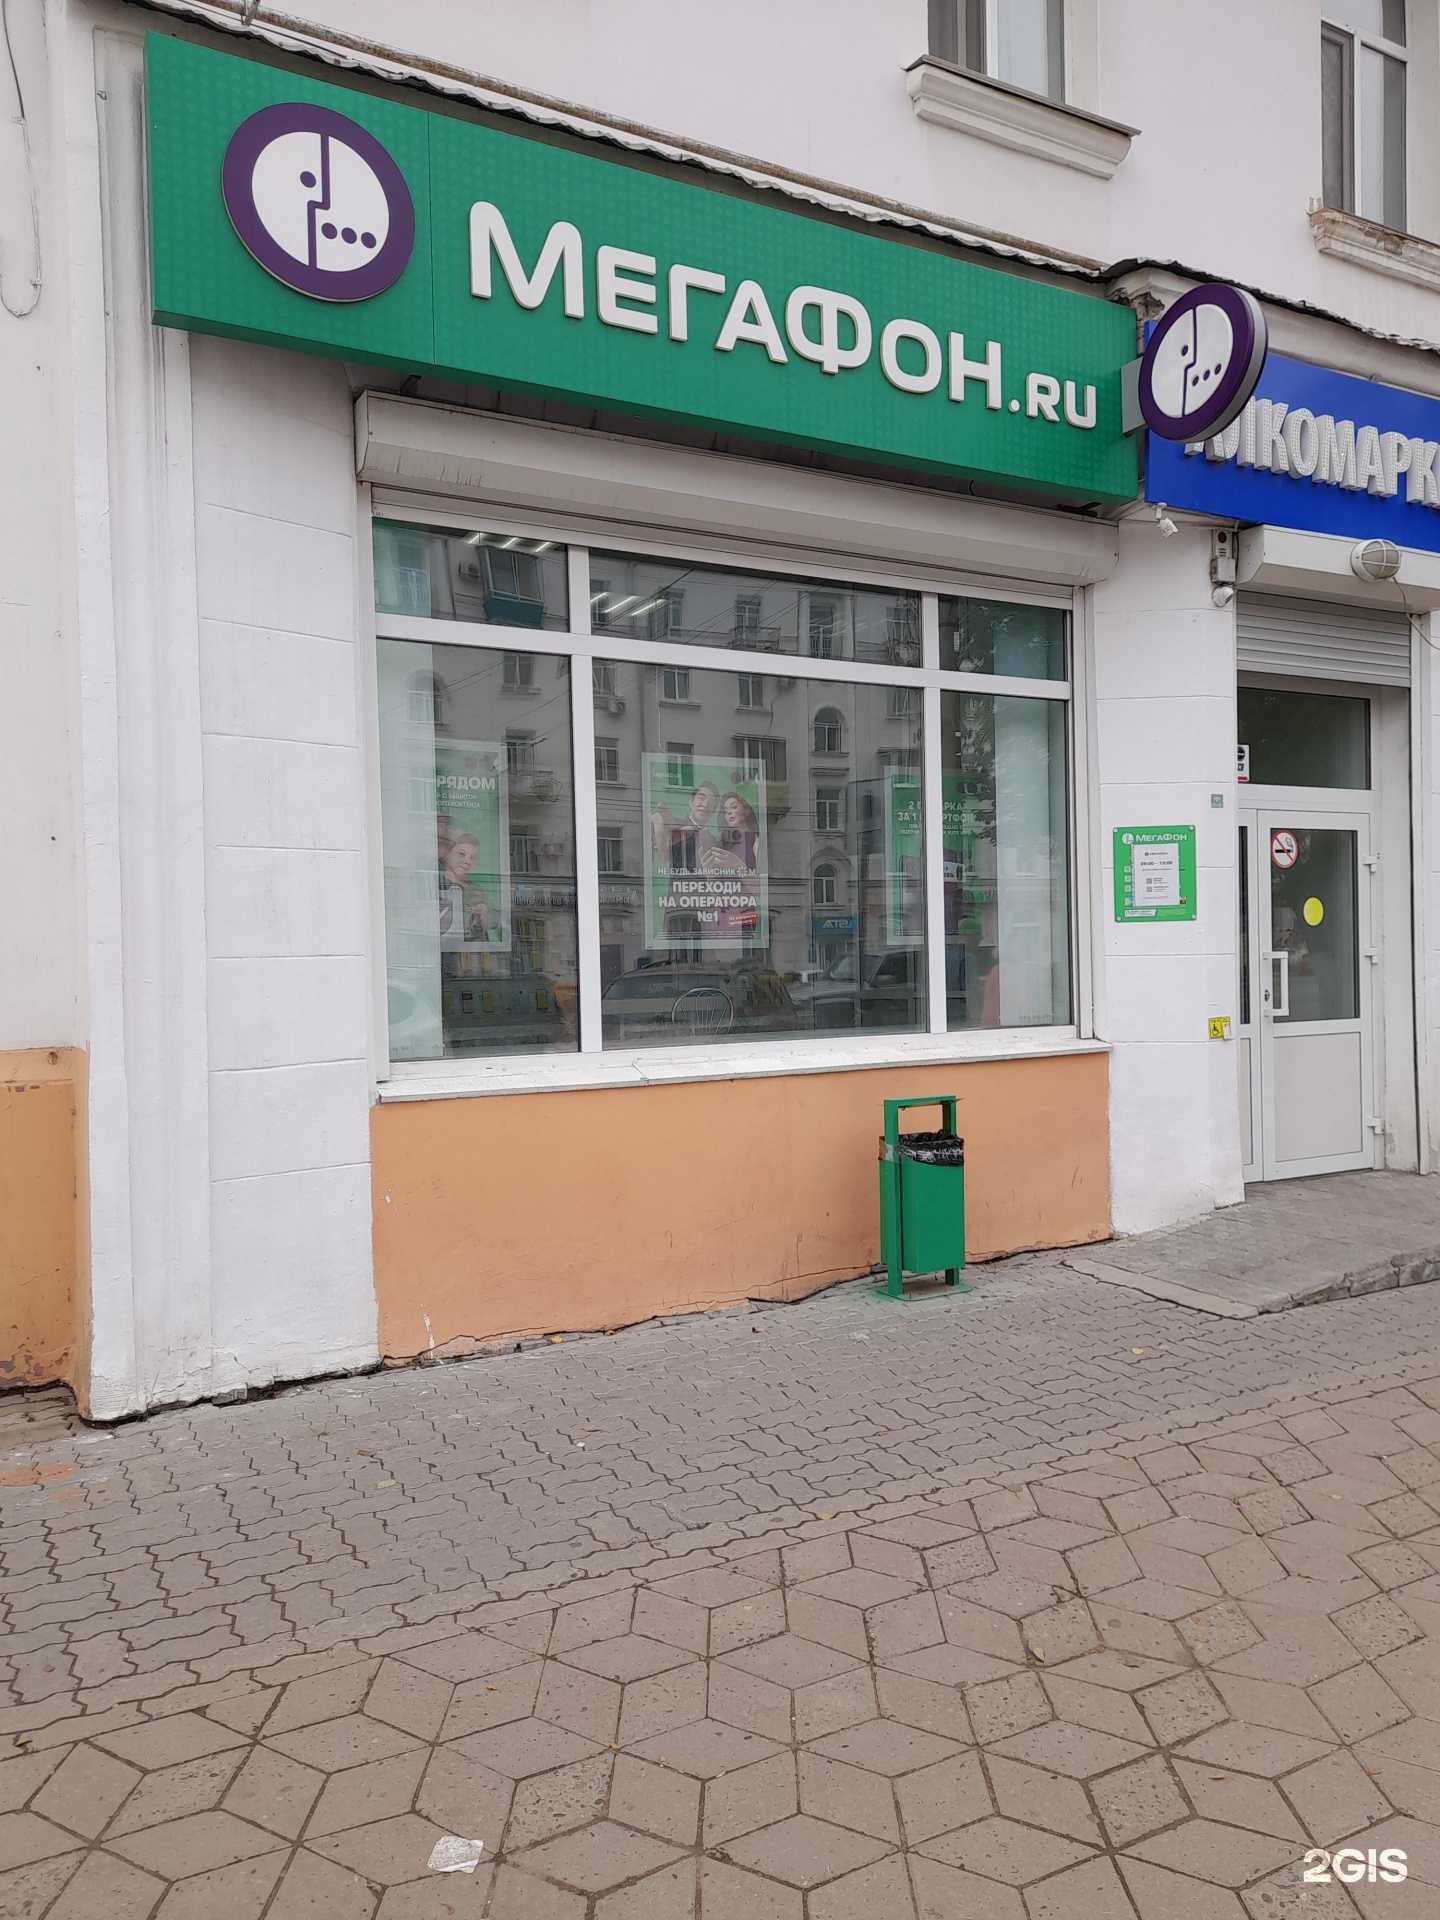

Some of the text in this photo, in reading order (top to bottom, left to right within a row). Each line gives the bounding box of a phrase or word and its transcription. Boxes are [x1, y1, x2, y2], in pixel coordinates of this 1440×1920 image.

[1184, 395, 1440, 509] ЛКОМАРК
[673, 881, 741, 895] ПЕРЕХОДИ
[659, 896, 757, 908] НА ОПЕРАТОРА
